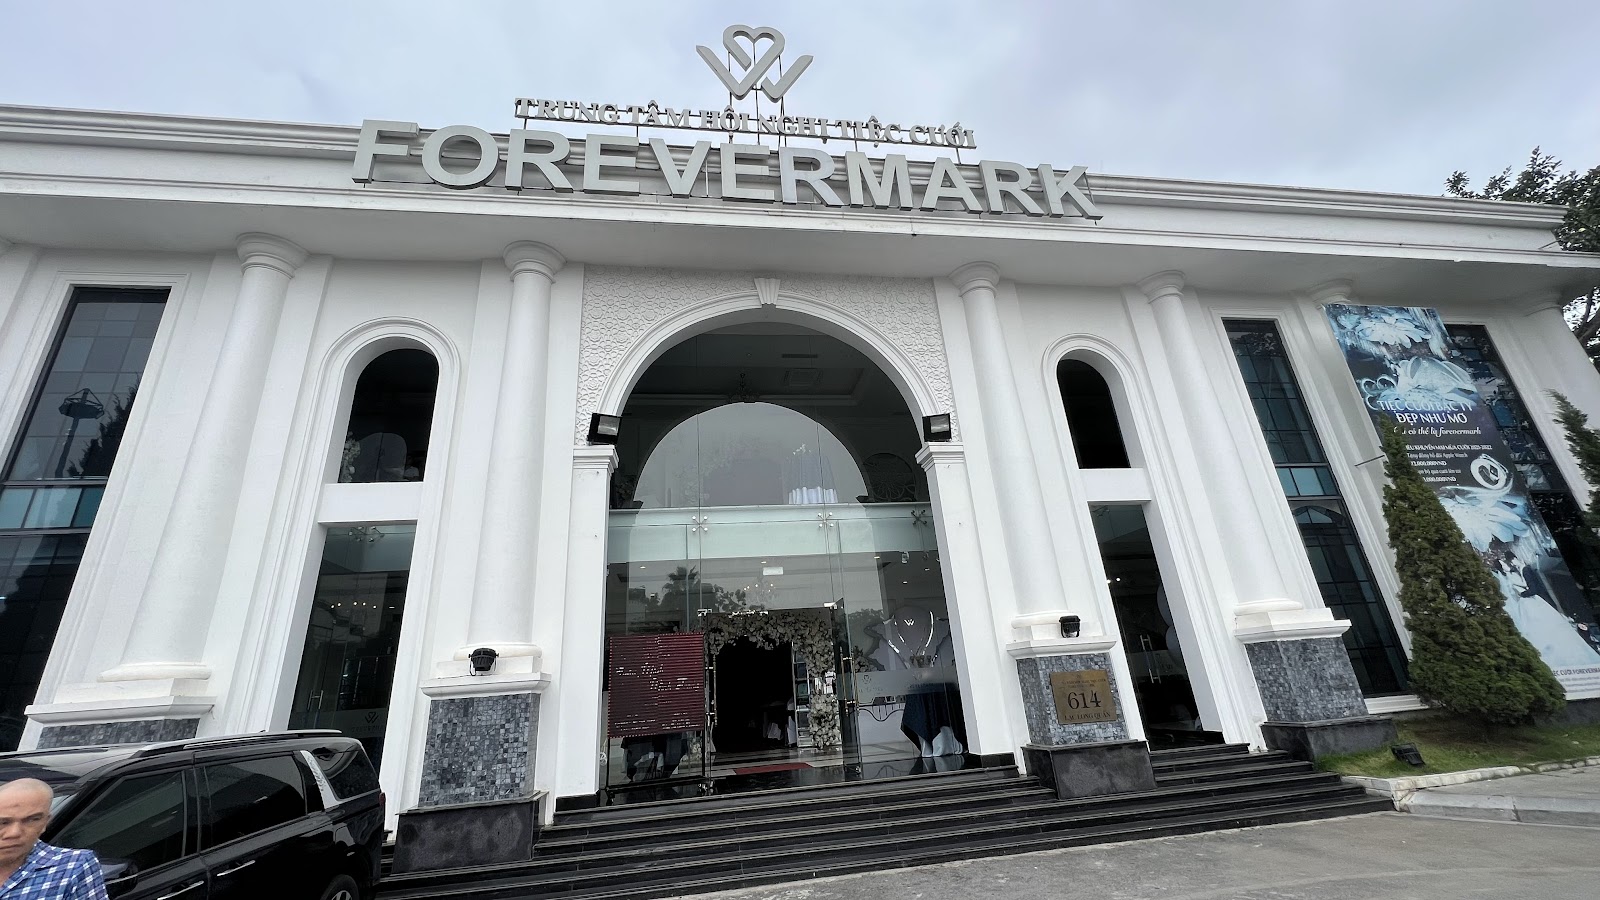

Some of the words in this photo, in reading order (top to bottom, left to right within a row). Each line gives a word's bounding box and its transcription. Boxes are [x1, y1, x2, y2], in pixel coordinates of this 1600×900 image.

[515, 97, 620, 125] TRUNG
[626, 100, 692, 128] TÂM
[759, 114, 829, 144] NGHỊ
[835, 115, 904, 148] TIỆC
[909, 122, 976, 147] CƯỚI
[352, 119, 1103, 220] FOREVERMARK
[1395, 413, 1419, 426] ĐẸP
[1420, 412, 1446, 423] NHƯ
[1067, 690, 1102, 709] 614
